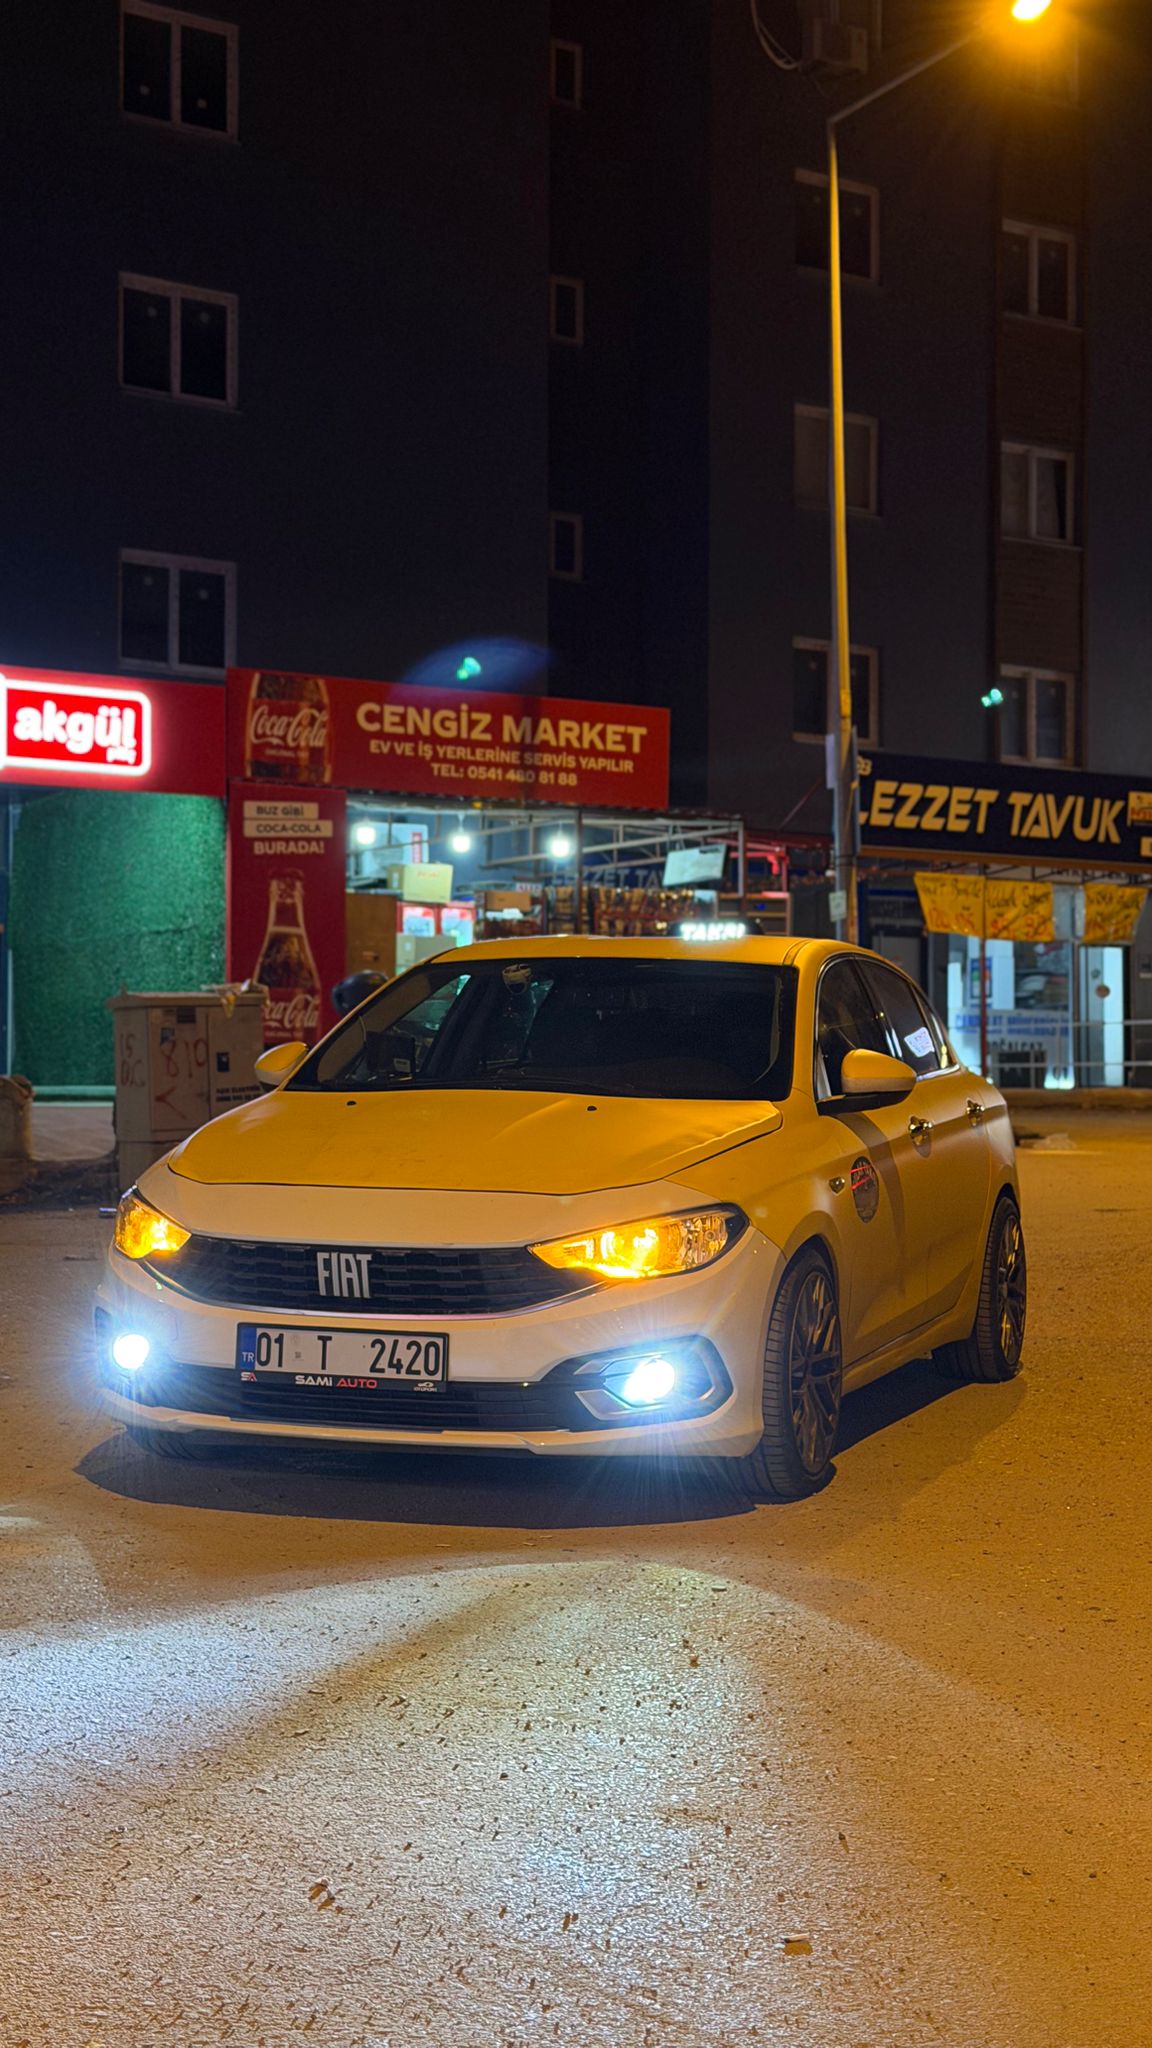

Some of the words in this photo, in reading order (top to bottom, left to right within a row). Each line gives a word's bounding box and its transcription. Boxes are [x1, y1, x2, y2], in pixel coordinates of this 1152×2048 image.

[13, 700, 137, 754] akgül
[251, 705, 329, 748] Coca-Cola
[356, 702, 492, 741] CENGİZ
[502, 715, 648, 754] MARKET
[369, 739, 391, 754] EV
[394, 741, 414, 756] VE
[418, 740, 433, 761] İŞ
[436, 745, 520, 765] YERLERİNE
[523, 751, 576, 768] SERVİS
[579, 756, 634, 773] YAPILIR
[431, 763, 464, 778] TEL:
[467, 765, 502, 781] 0541
[539, 771, 554, 785] 81
[557, 773, 577, 787] 88
[256, 805, 278, 816] BUZ
[281, 805, 304, 817] GİBİ
[256, 823, 321, 833] COCA-COLA
[859, 780, 999, 834] EZZET
[1007, 791, 1125, 844] TAVUK
[253, 840, 325, 855] BURADA!
[316, 1251, 372, 1299] FIAT
[242, 1351, 255, 1362] TR
[256, 1331, 284, 1368] 01
[317, 1335, 333, 1371] T
[369, 1338, 440, 1376] 2420
[336, 1377, 378, 1389] AUTO
